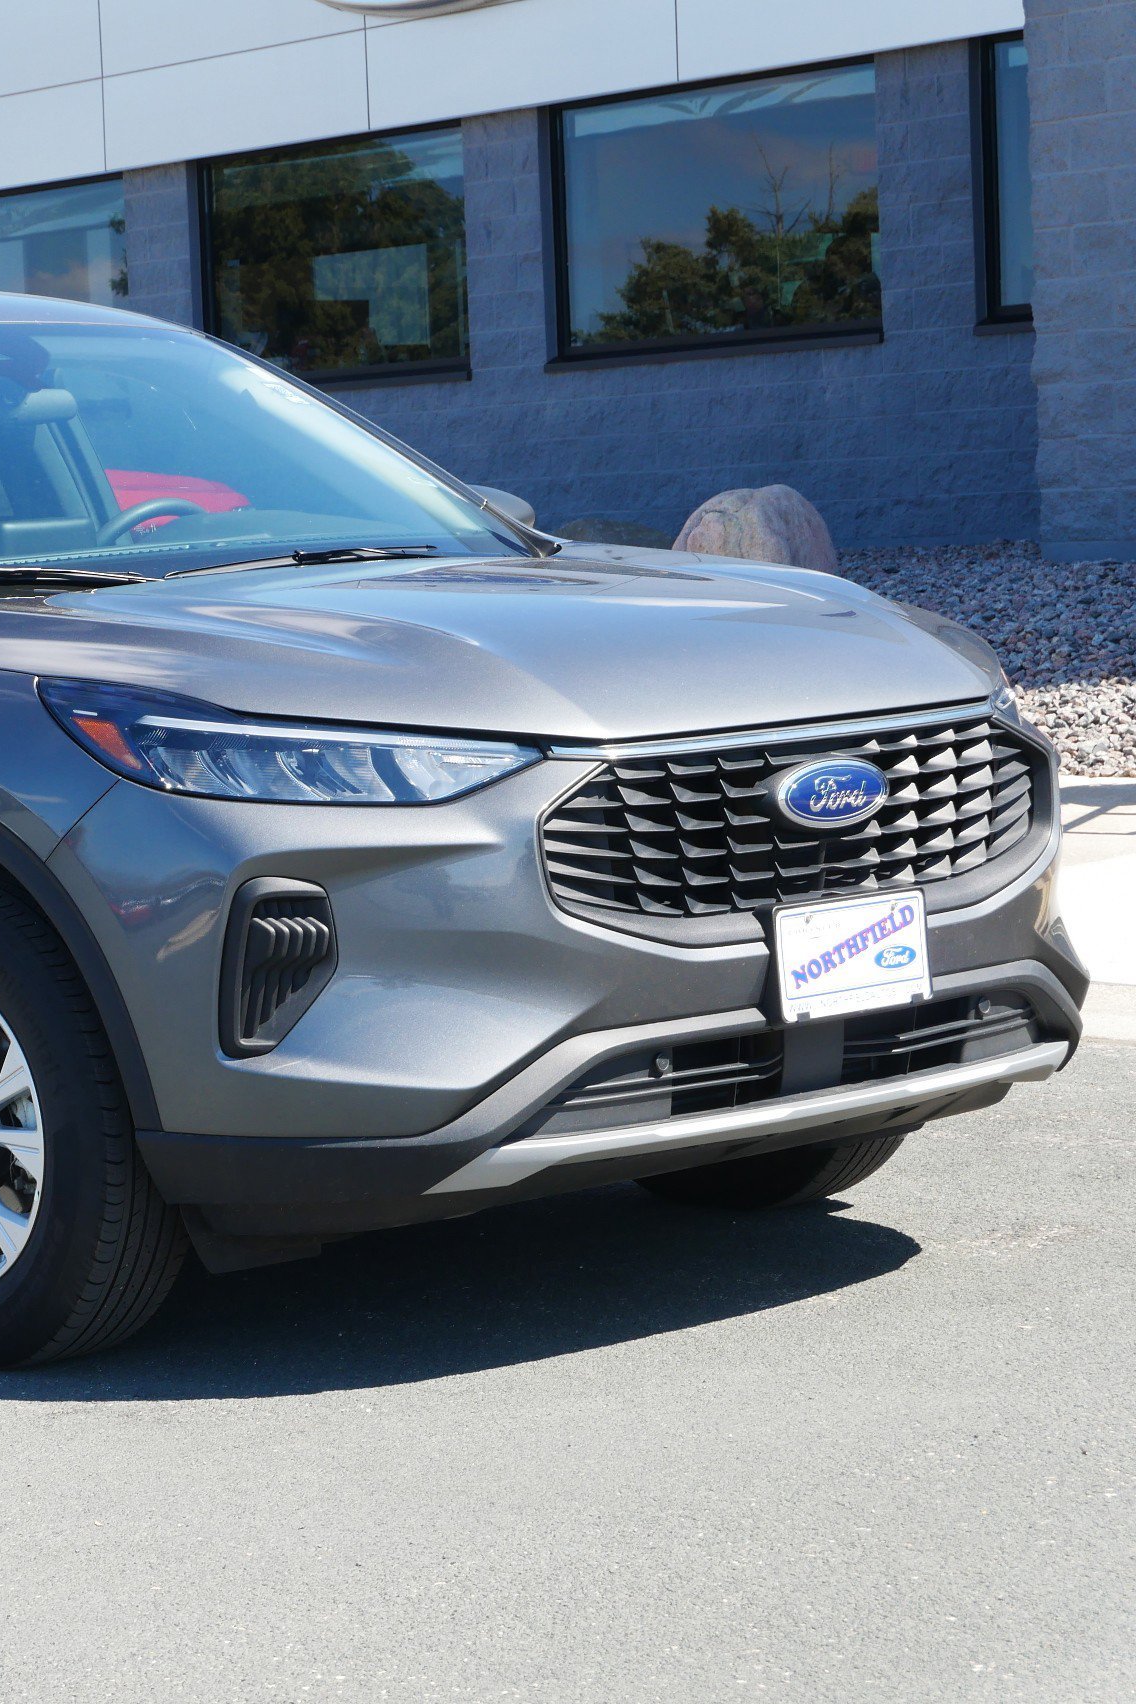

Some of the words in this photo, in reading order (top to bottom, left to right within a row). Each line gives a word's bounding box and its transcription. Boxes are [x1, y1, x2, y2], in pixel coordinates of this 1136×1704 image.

[810, 774, 867, 812] Ford
[791, 904, 915, 990] NORTHFIELD
[881, 946, 910, 967] Ford
